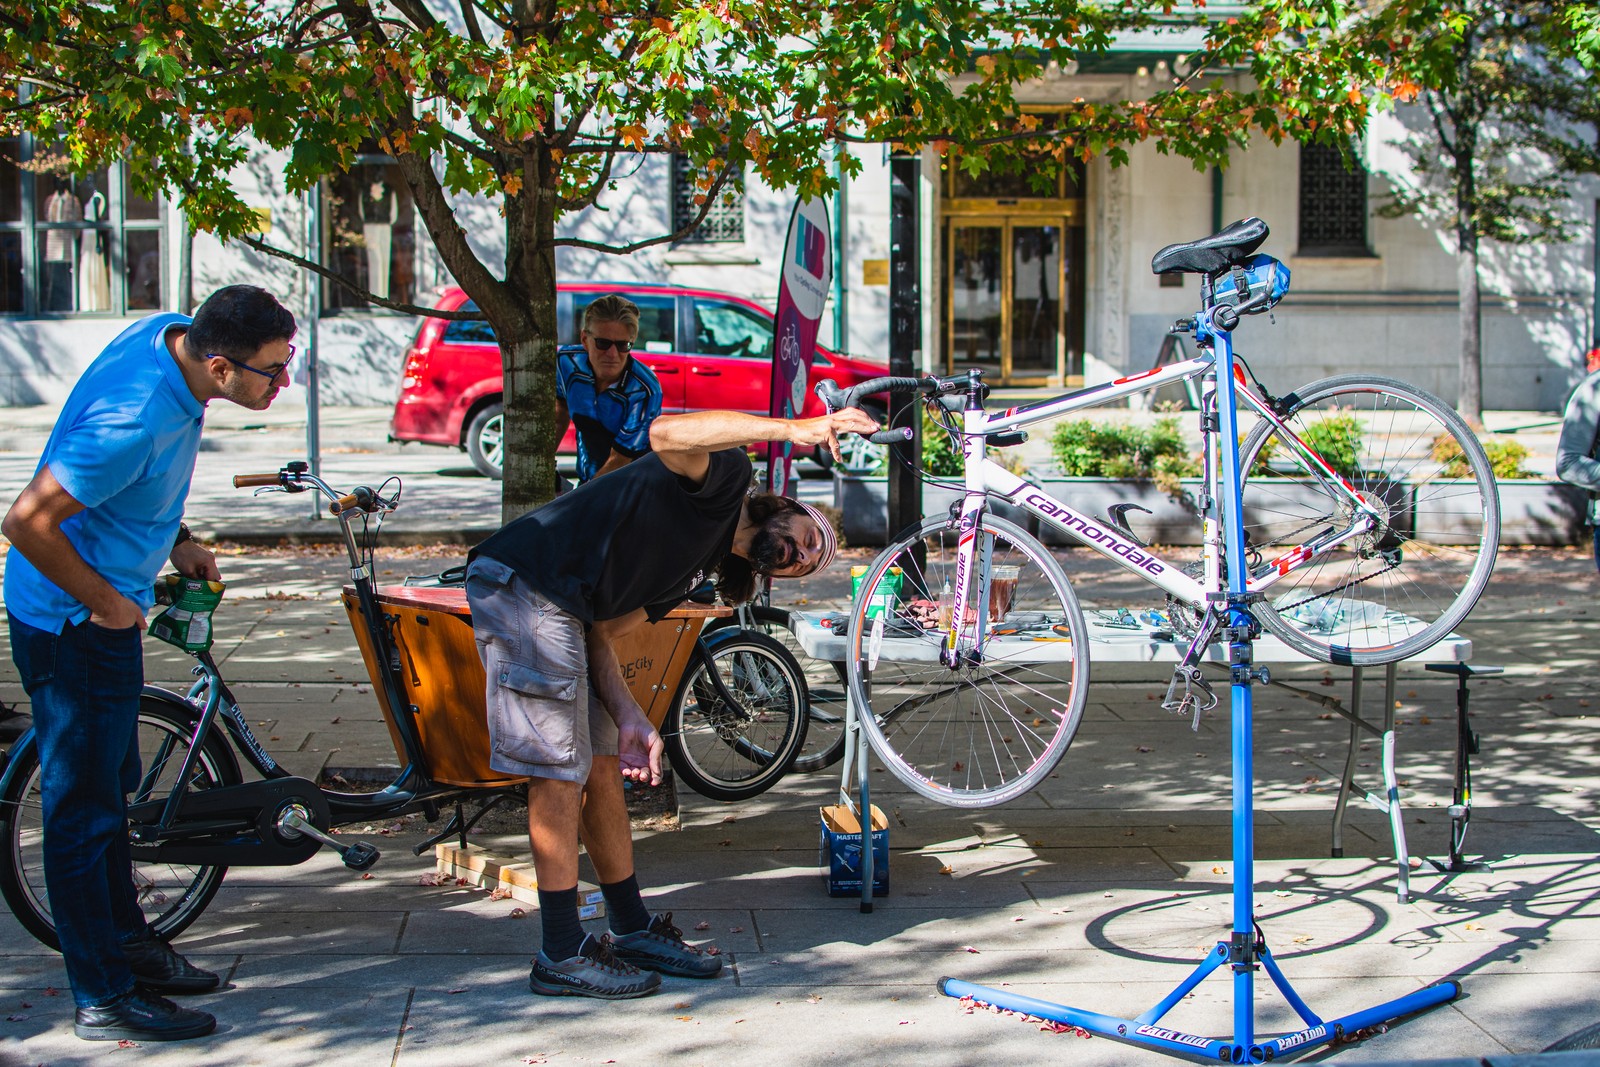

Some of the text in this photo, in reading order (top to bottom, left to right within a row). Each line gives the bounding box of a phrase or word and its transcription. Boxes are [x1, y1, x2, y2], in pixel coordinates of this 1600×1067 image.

[1026, 494, 1165, 576] cannondale
[952, 552, 966, 633] annondale
[635, 656, 653, 671] City
[231, 704, 247, 730] CYCLE
[257, 746, 276, 770] TOURS
